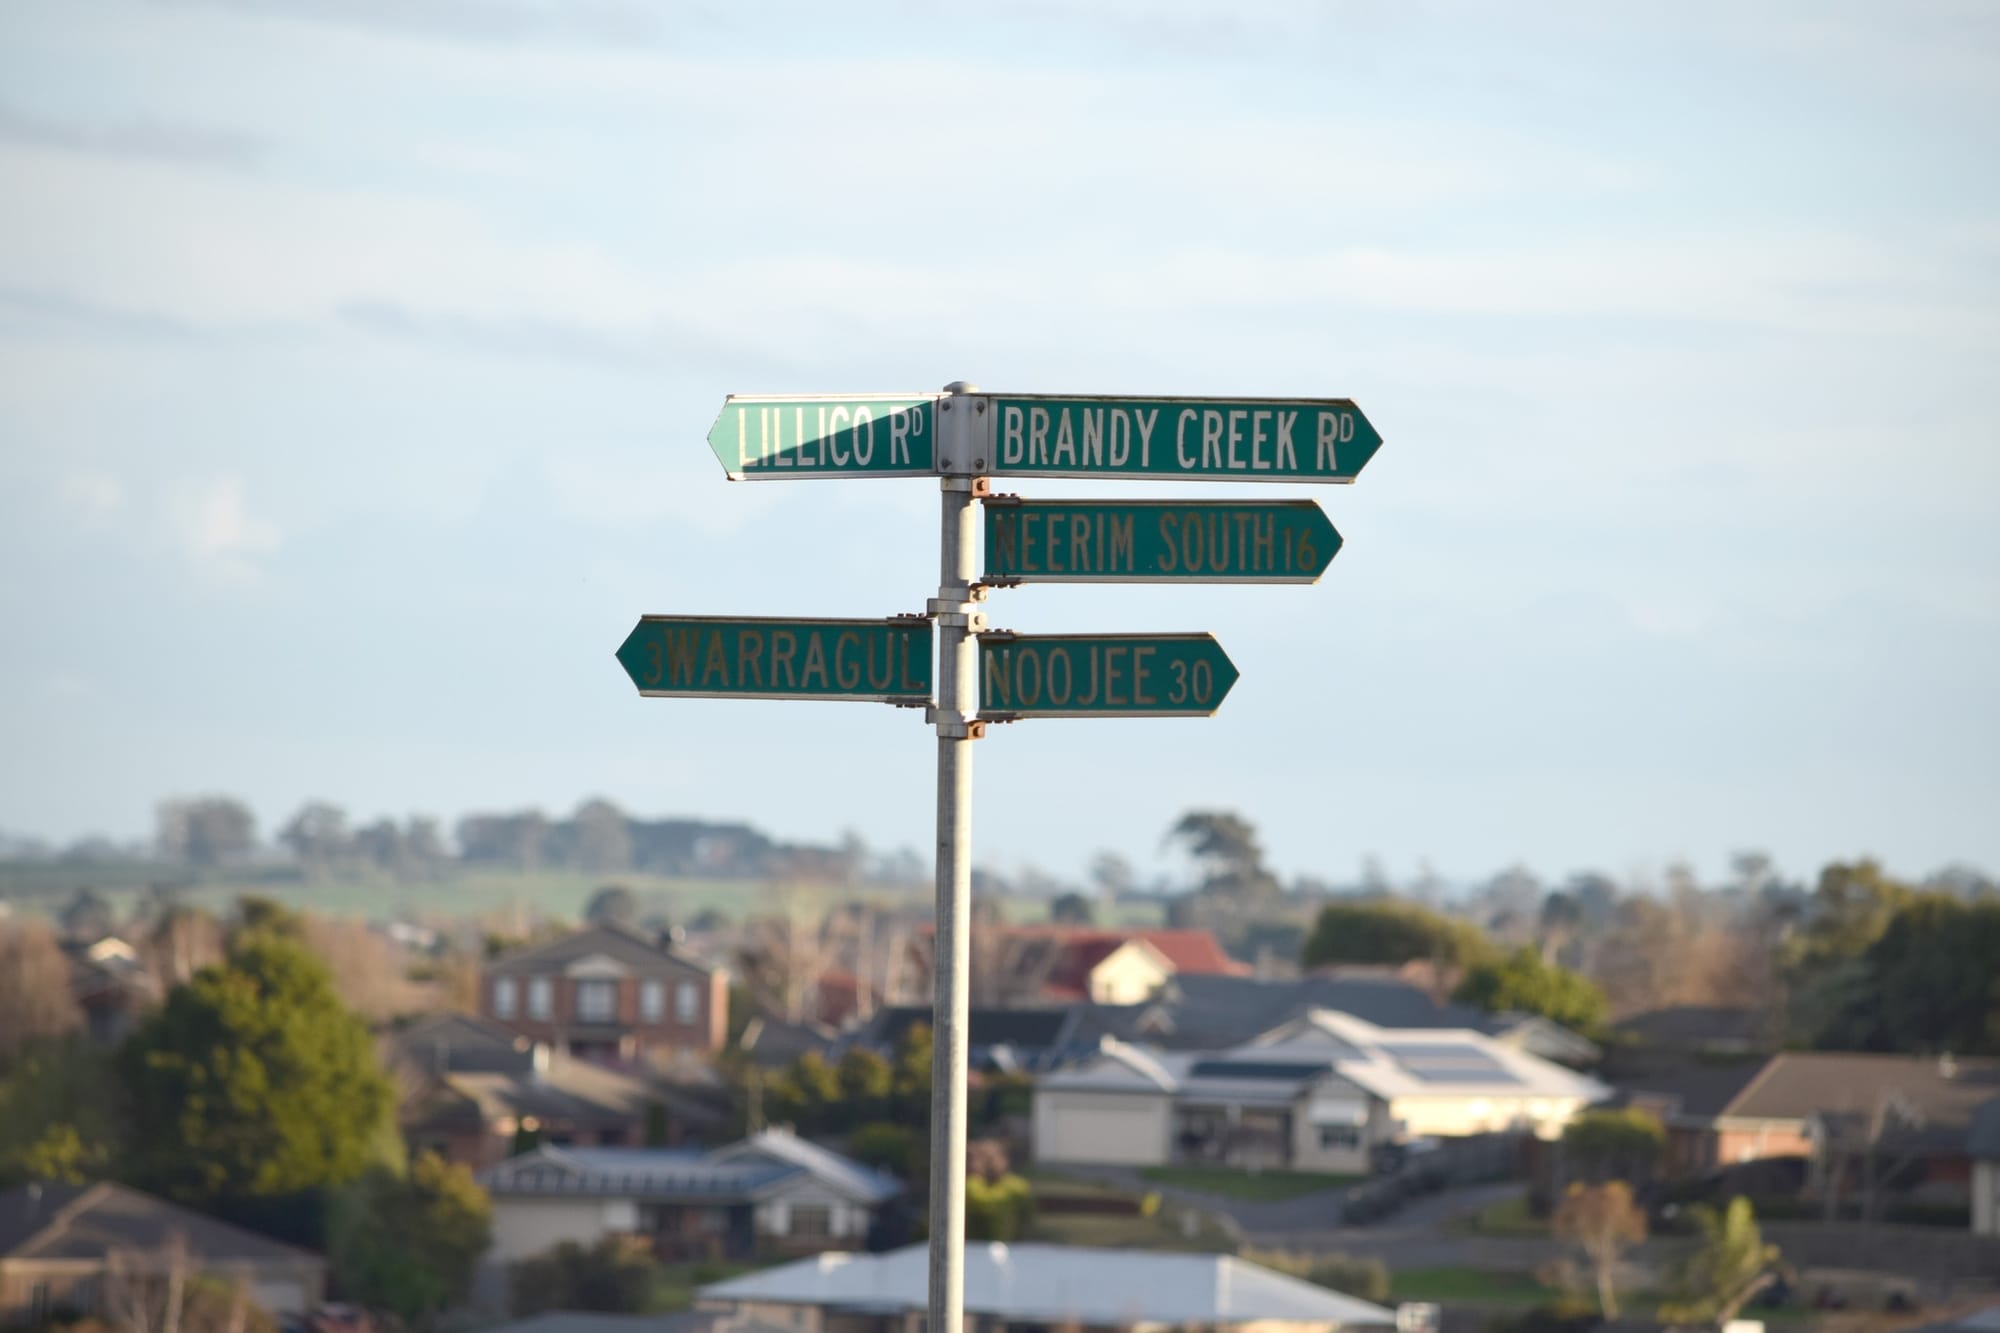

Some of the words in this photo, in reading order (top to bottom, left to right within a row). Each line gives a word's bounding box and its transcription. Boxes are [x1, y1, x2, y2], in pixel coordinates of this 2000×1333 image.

[739, 406, 873, 466] LILLICO
[1003, 406, 1159, 467] BRANDY
[1176, 408, 1298, 469] CREEK
[995, 513, 1134, 572] NEERIM
[1158, 511, 1274, 572] SOUTH
[1284, 527, 1316, 572] 16
[643, 642, 661, 685] 3
[665, 628, 925, 690] WARRAGUL
[985, 646, 1156, 706] NOOJEE
[1168, 659, 1213, 704] 30
